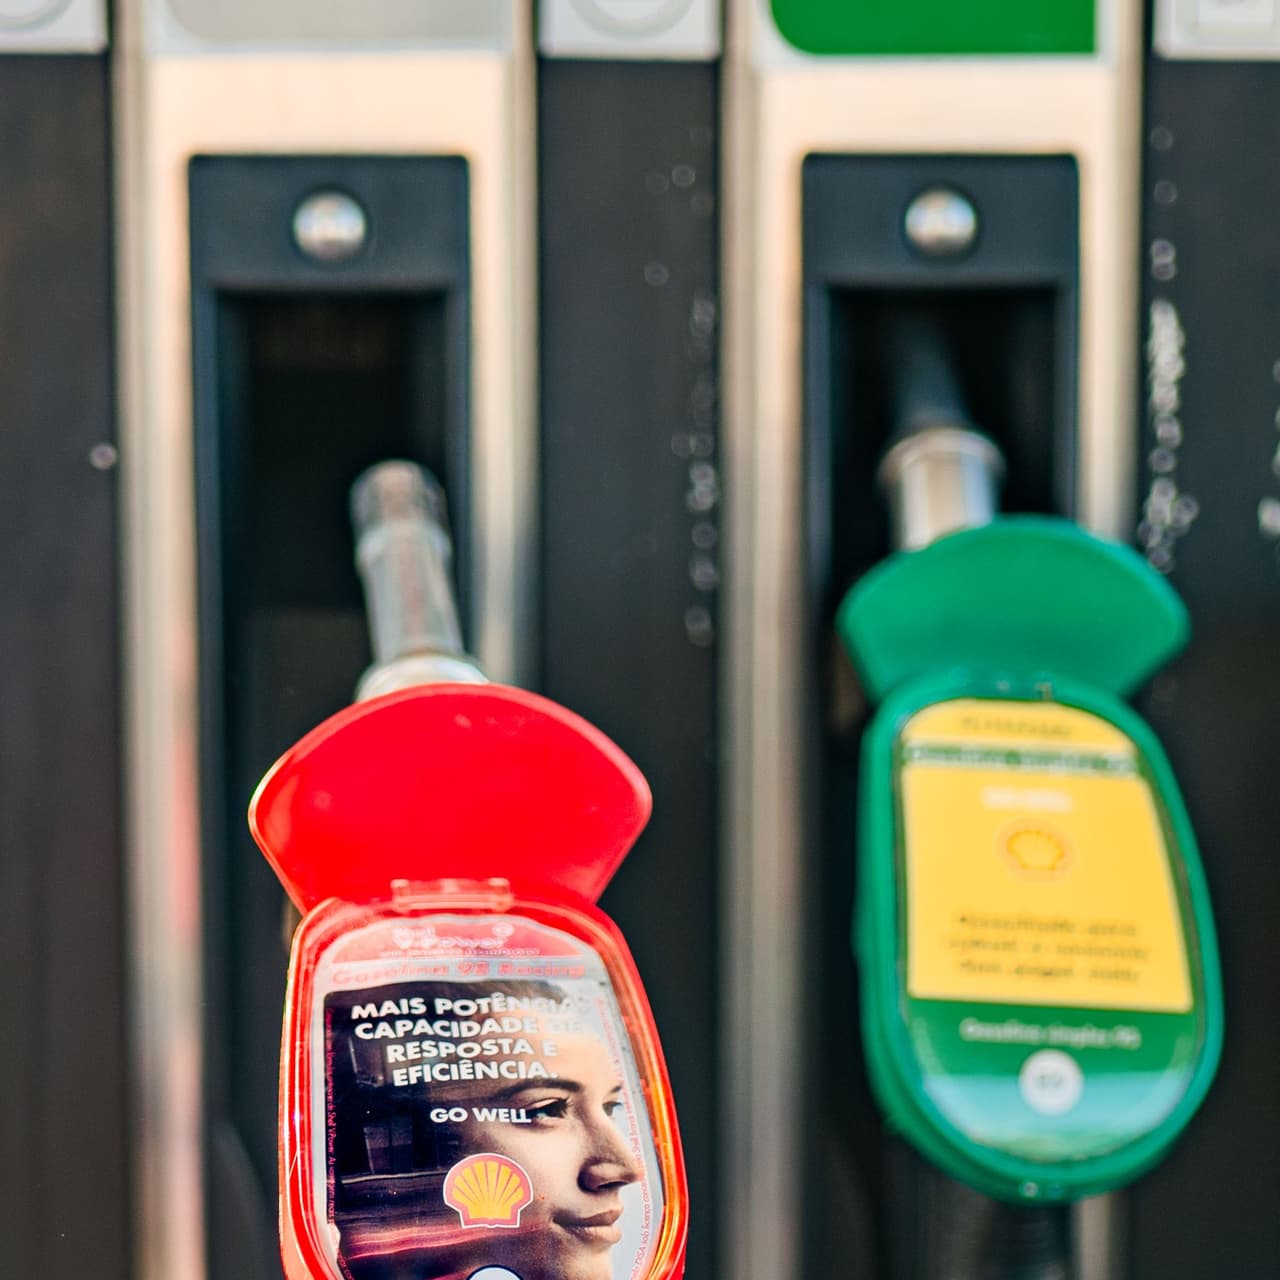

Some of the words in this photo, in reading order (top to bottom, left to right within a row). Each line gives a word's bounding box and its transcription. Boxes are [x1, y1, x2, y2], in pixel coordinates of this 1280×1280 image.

[351, 997, 427, 1020] MAIS
[354, 1015, 539, 1040] CAPACIDADE
[386, 1038, 535, 1064] RESPOSTA
[541, 1039, 559, 1057] E
[392, 1059, 559, 1088] EFICIÊNCIA.
[429, 1107, 469, 1124] GO
[471, 1107, 532, 1124] WELL
